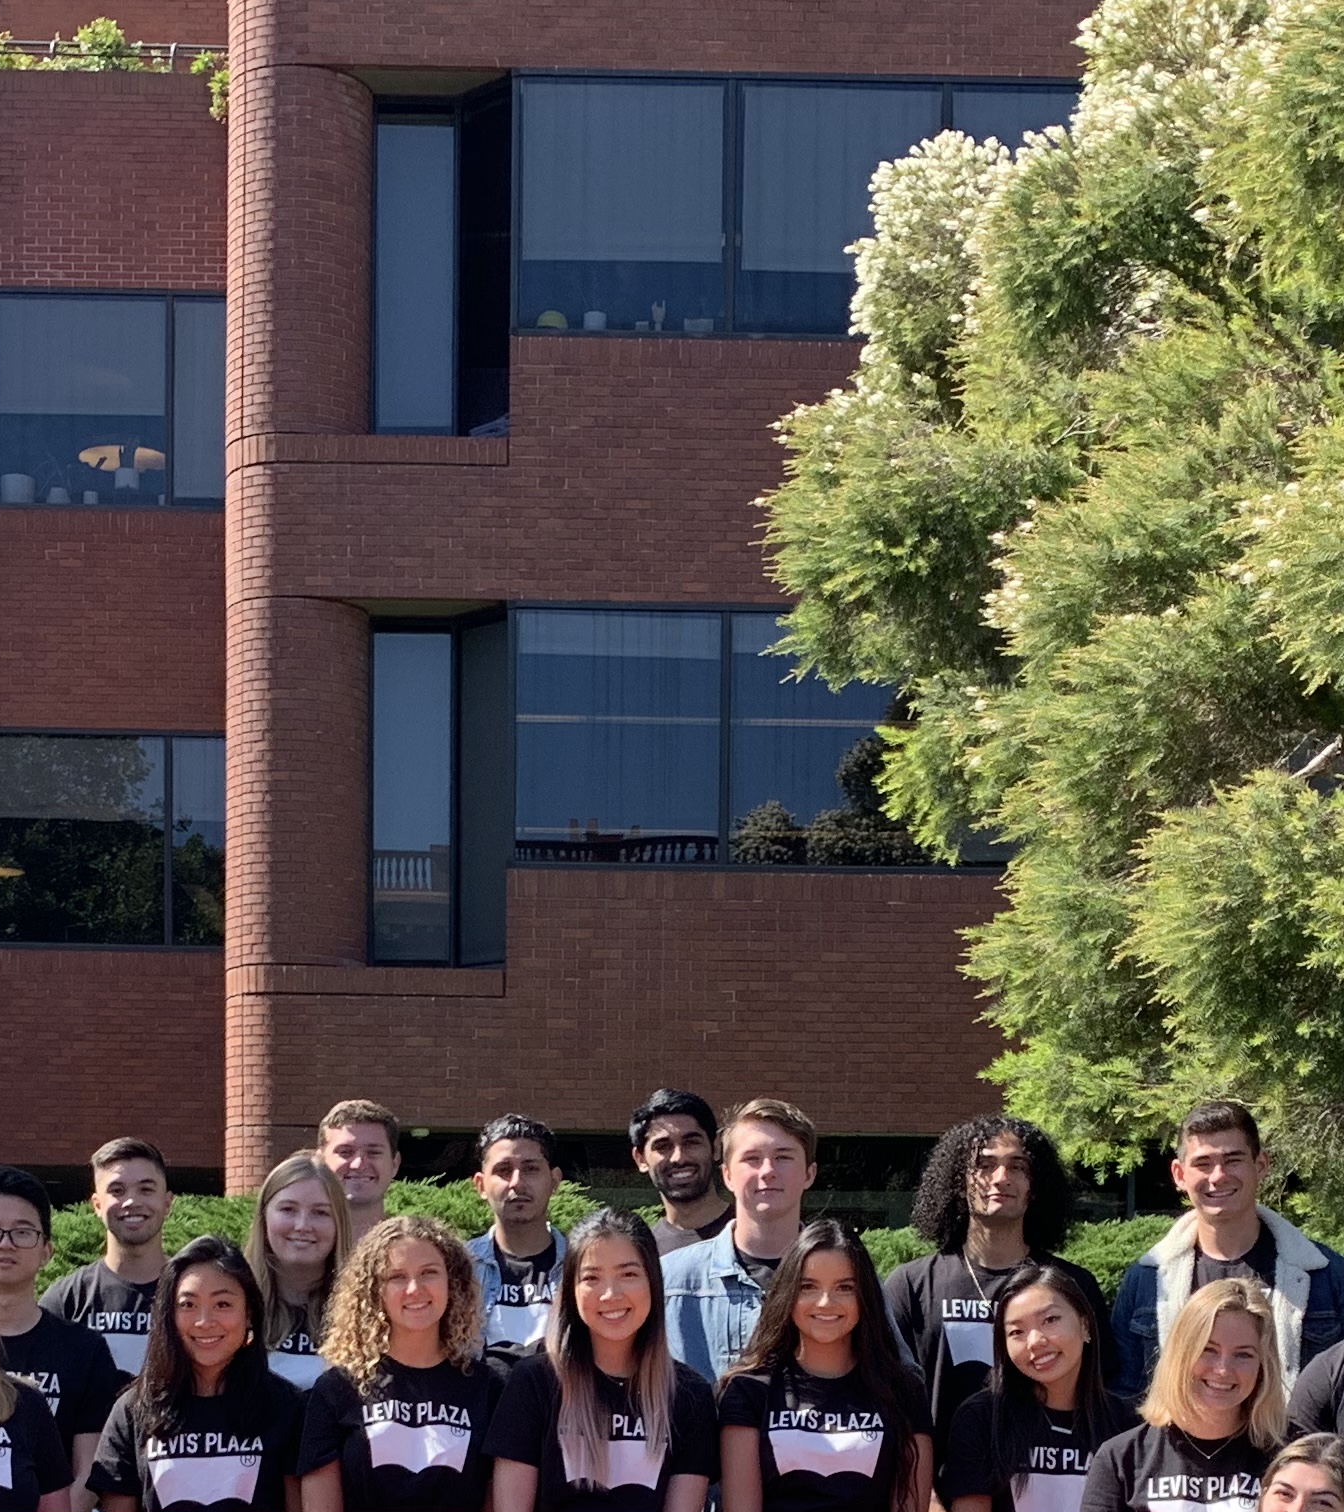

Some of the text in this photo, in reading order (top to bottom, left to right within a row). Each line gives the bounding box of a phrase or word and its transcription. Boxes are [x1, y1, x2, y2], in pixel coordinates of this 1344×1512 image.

[416, 1401, 471, 1428] PLAZA
[611, 1413, 646, 1437] PLA
[824, 1412, 885, 1432] PLAZA
[205, 1431, 264, 1453] PLAZA
[1206, 1472, 1261, 1501] PLAZA
